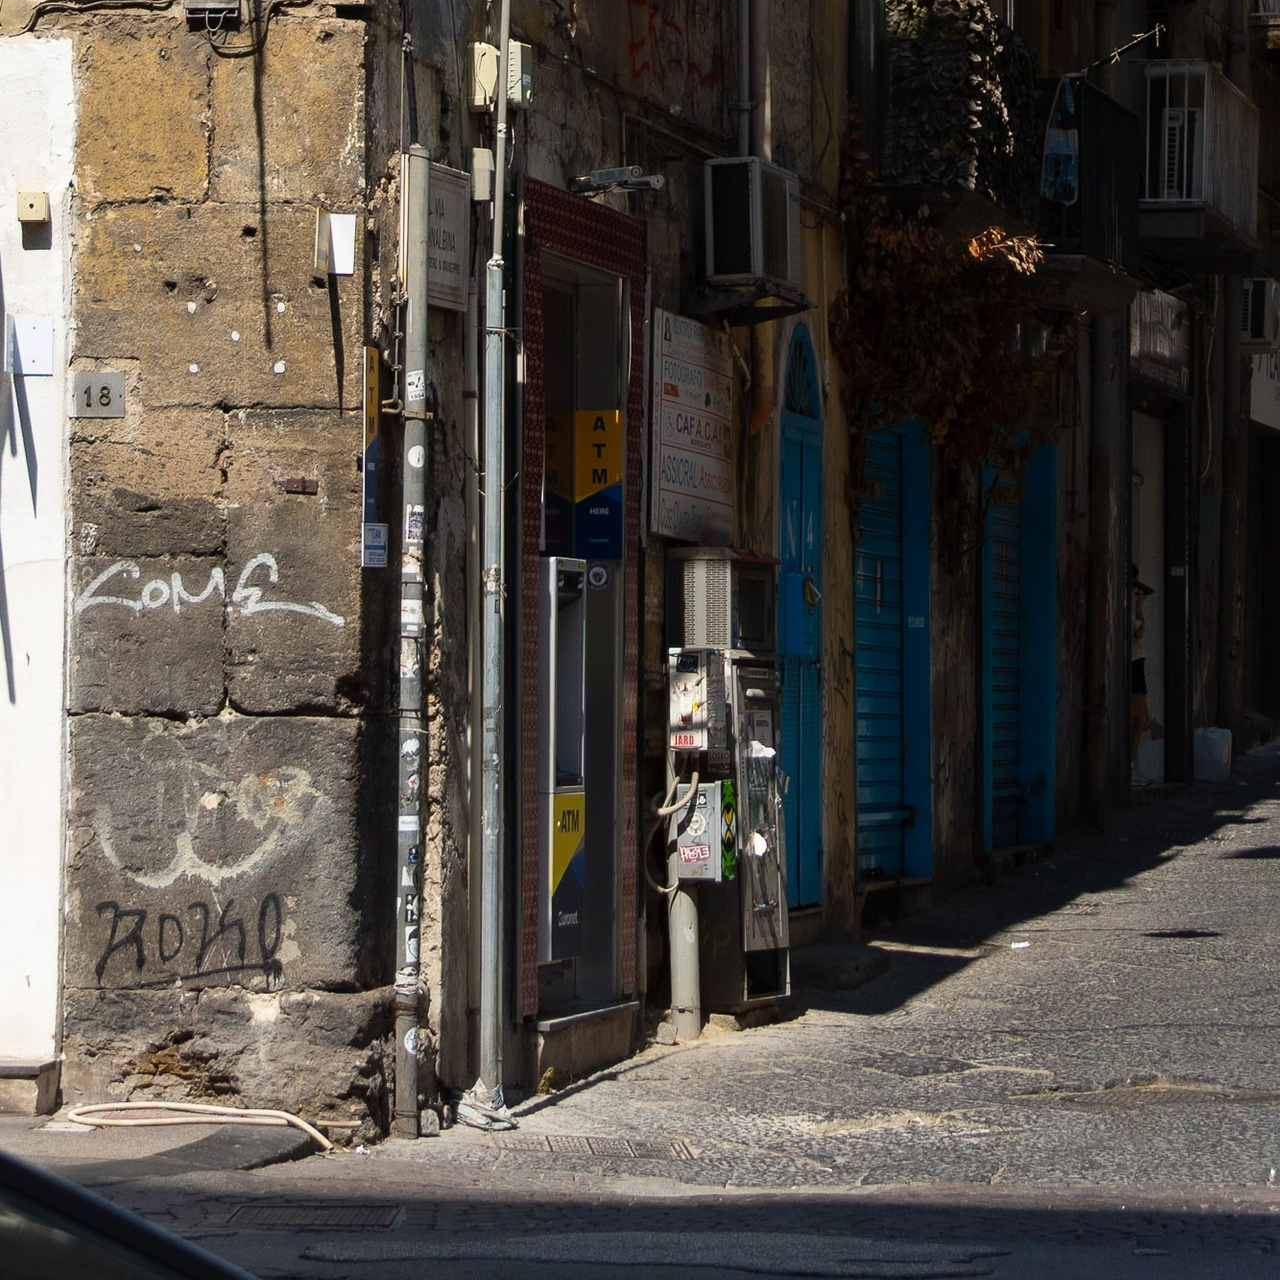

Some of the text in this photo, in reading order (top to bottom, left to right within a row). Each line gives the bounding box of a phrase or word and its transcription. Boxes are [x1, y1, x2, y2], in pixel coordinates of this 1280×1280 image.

[434, 196, 445, 221] VIA
[664, 360, 702, 388] FOTOGRAFO
[84, 385, 112, 408] 18
[368, 355, 376, 434] ATM
[676, 412, 695, 436] CAF
[592, 416, 608, 484] ATM
[589, 507, 611, 515] HERE
[674, 734, 694, 746] JARD
[560, 809, 580, 833] ATM
